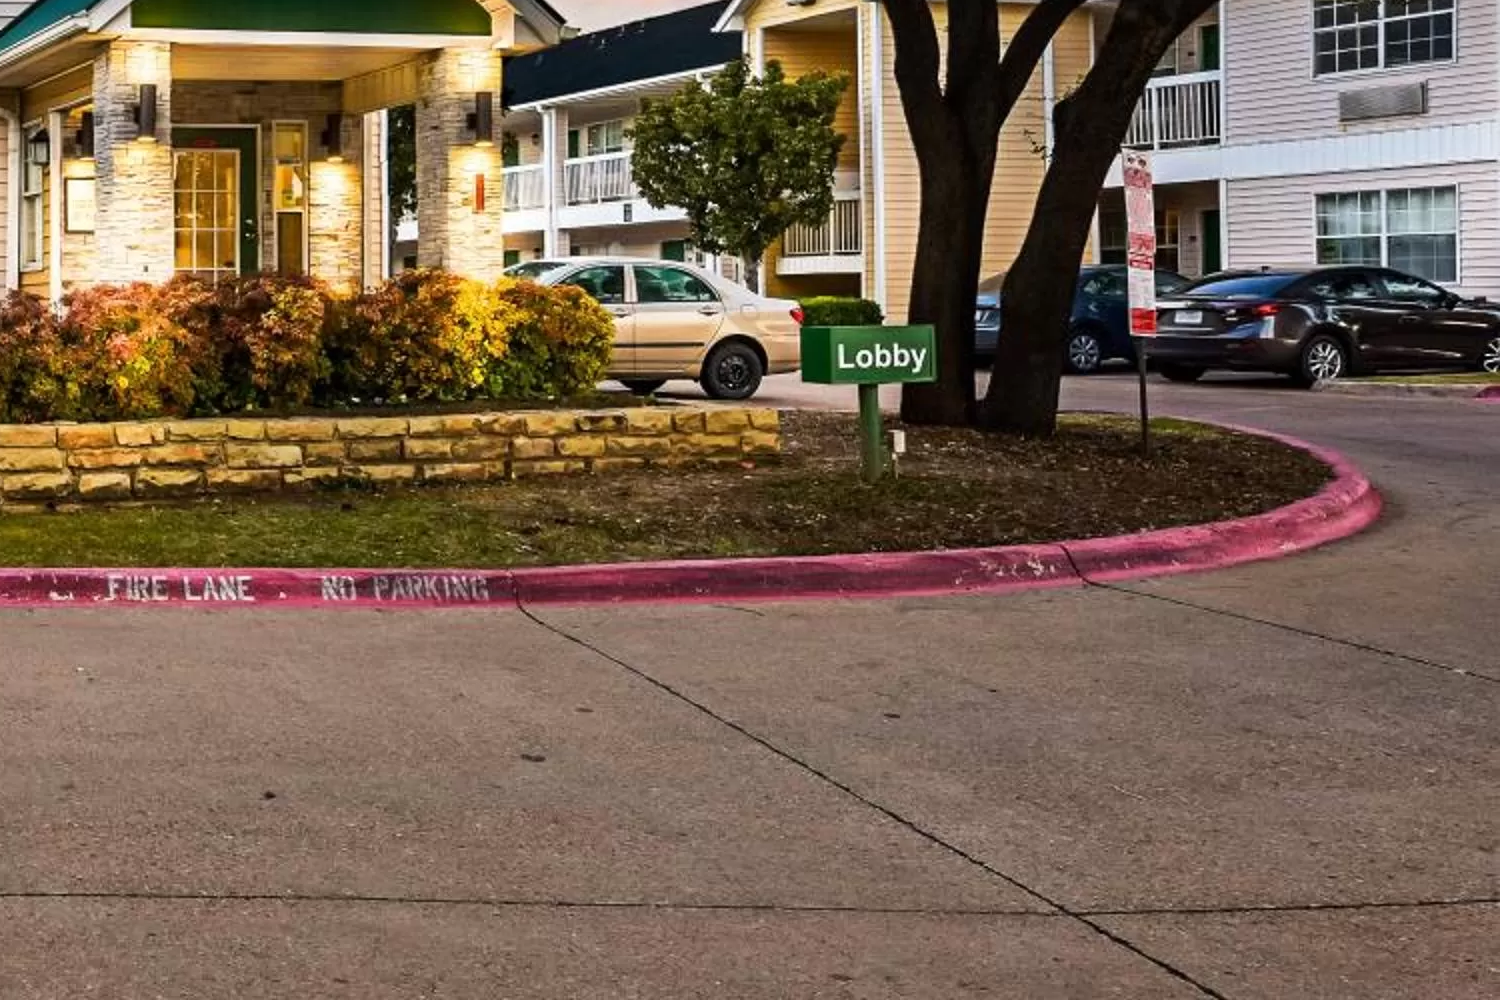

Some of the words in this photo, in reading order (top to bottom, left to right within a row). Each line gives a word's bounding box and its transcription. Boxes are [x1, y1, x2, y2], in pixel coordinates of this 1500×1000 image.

[837, 342, 927, 373] Lobby
[104, 575, 169, 601] FIRE
[182, 575, 255, 601] LANE
[320, 575, 357, 601] NO
[373, 575, 490, 602] PARKING
